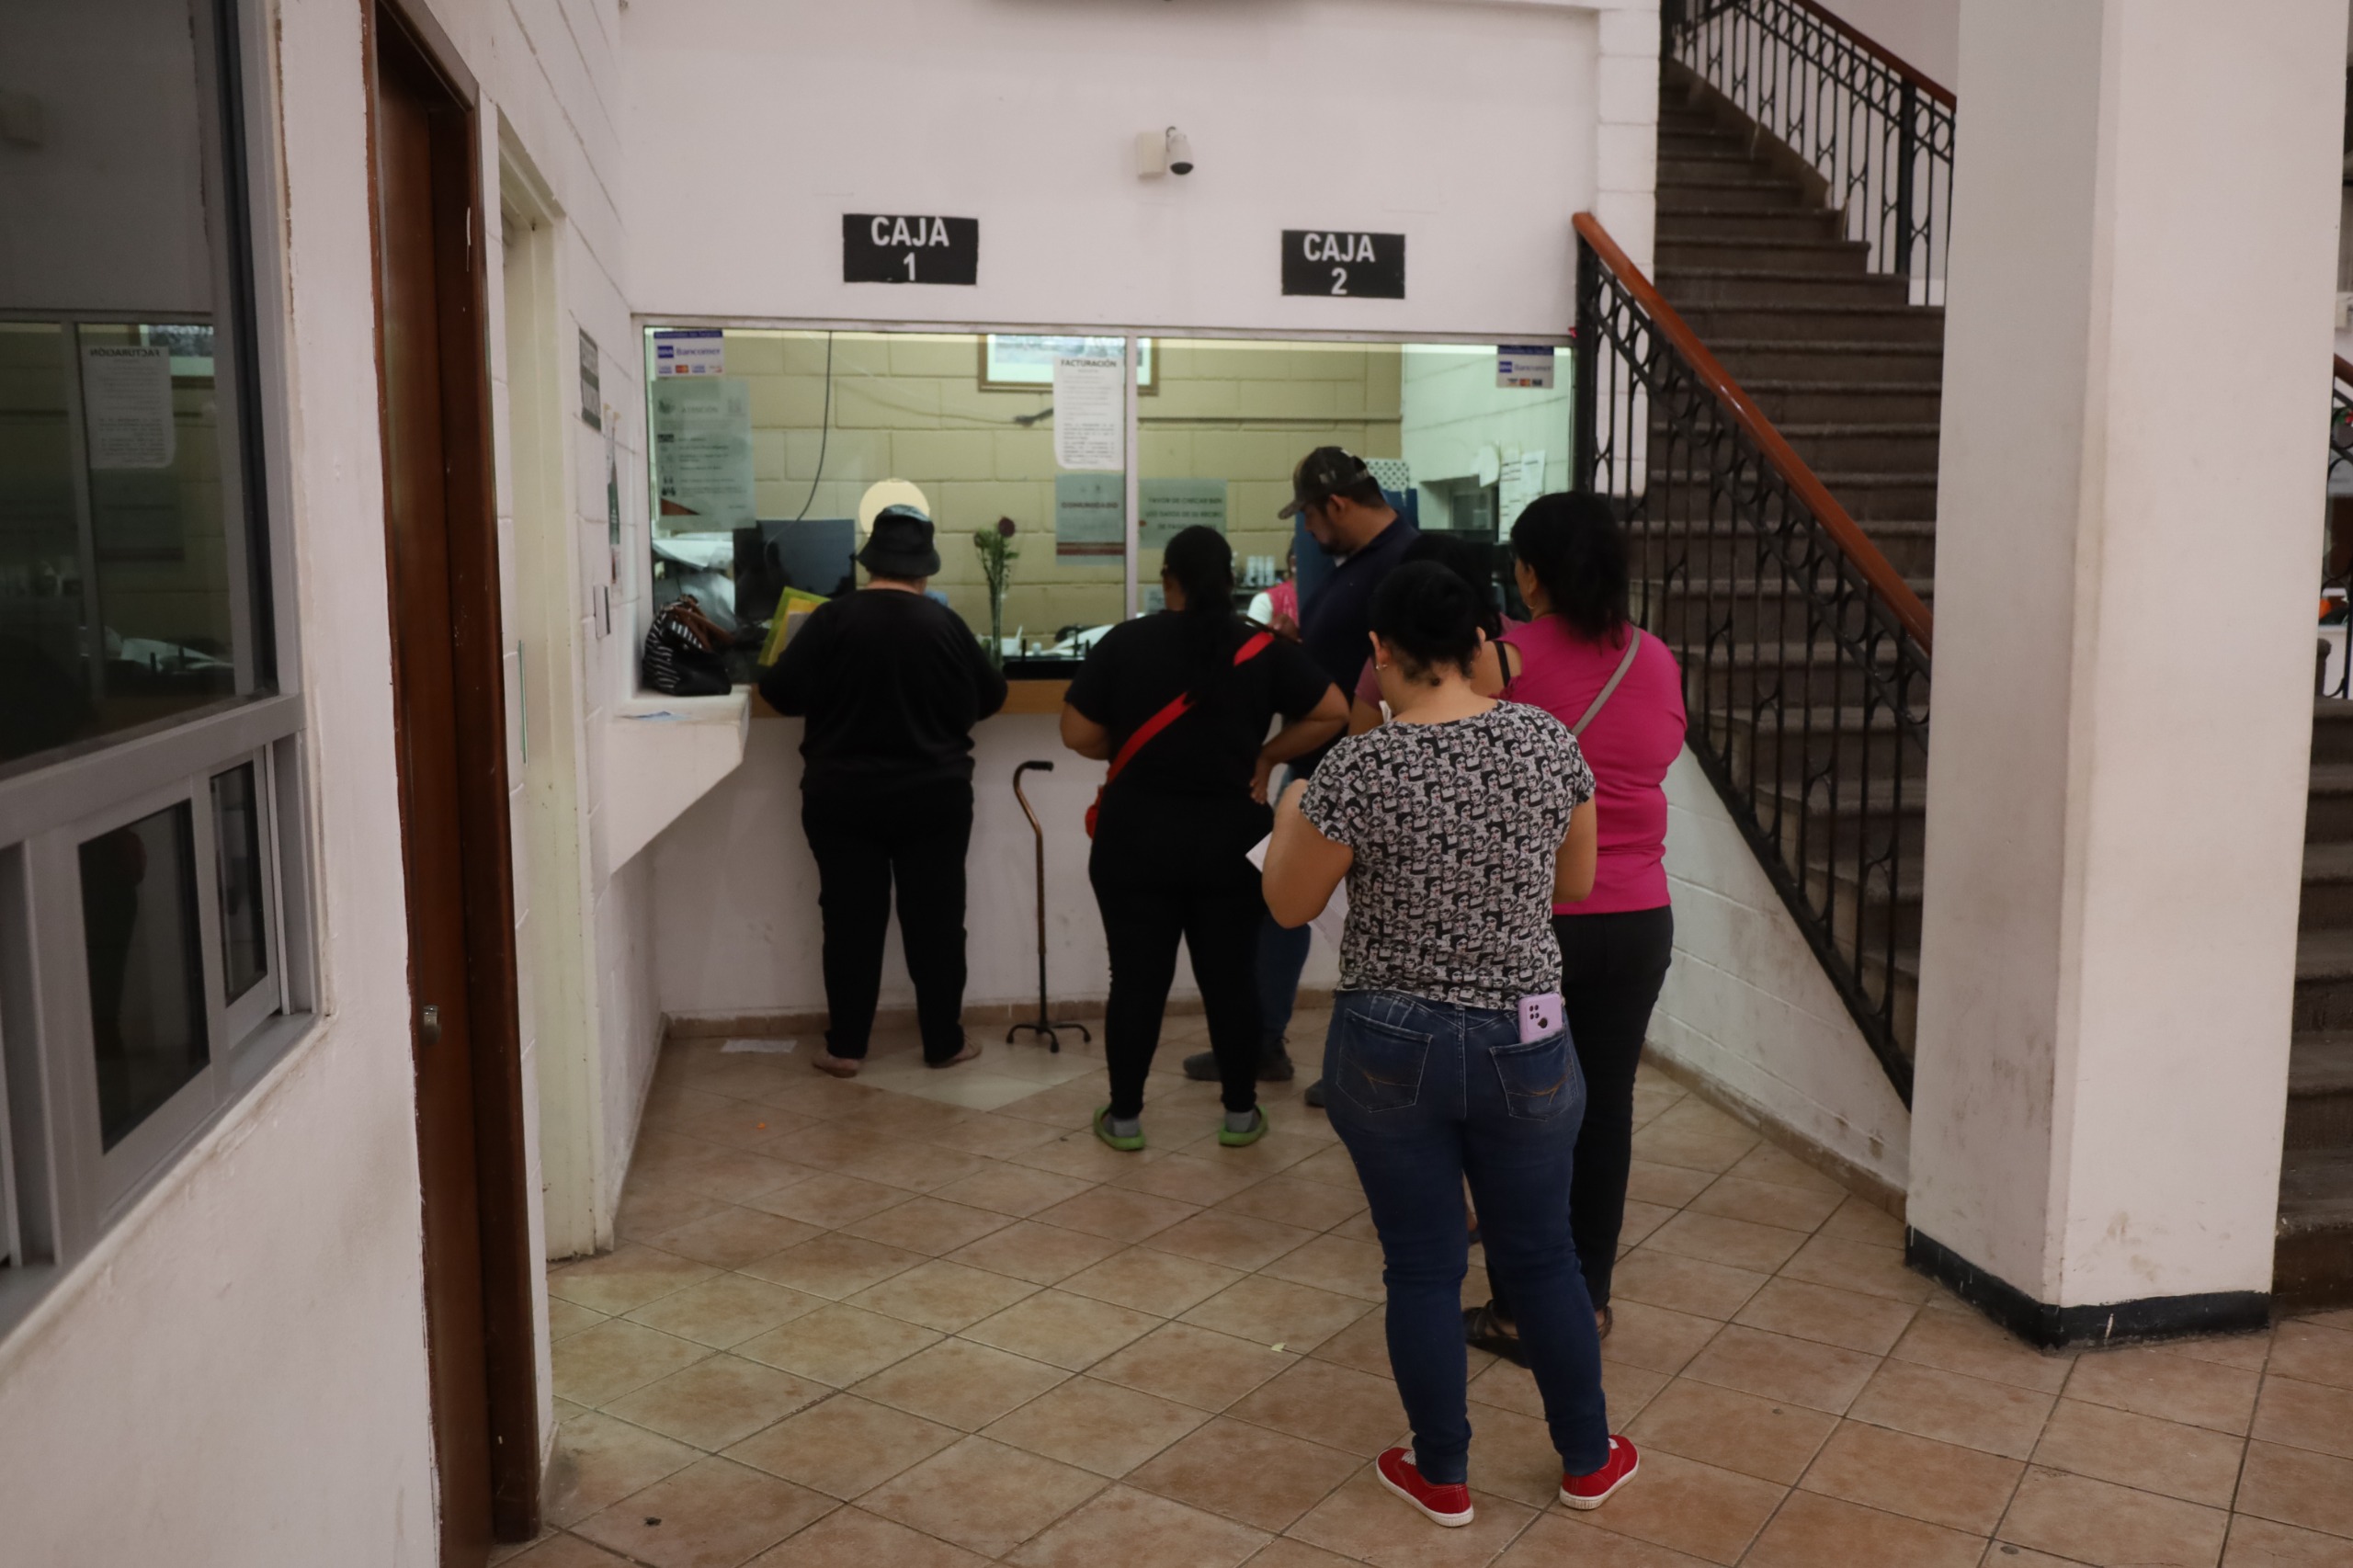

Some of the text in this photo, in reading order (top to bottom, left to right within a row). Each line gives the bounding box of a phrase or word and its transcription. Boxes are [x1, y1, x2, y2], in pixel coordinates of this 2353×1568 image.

[870, 215, 950, 247] CAJA
[1302, 233, 1376, 263] CAJA
[903, 252, 916, 281] 1
[1330, 267, 1348, 295] 2
[676, 347, 721, 356] Bancomer
[1061, 358, 1117, 368] FACTURACIÓN
